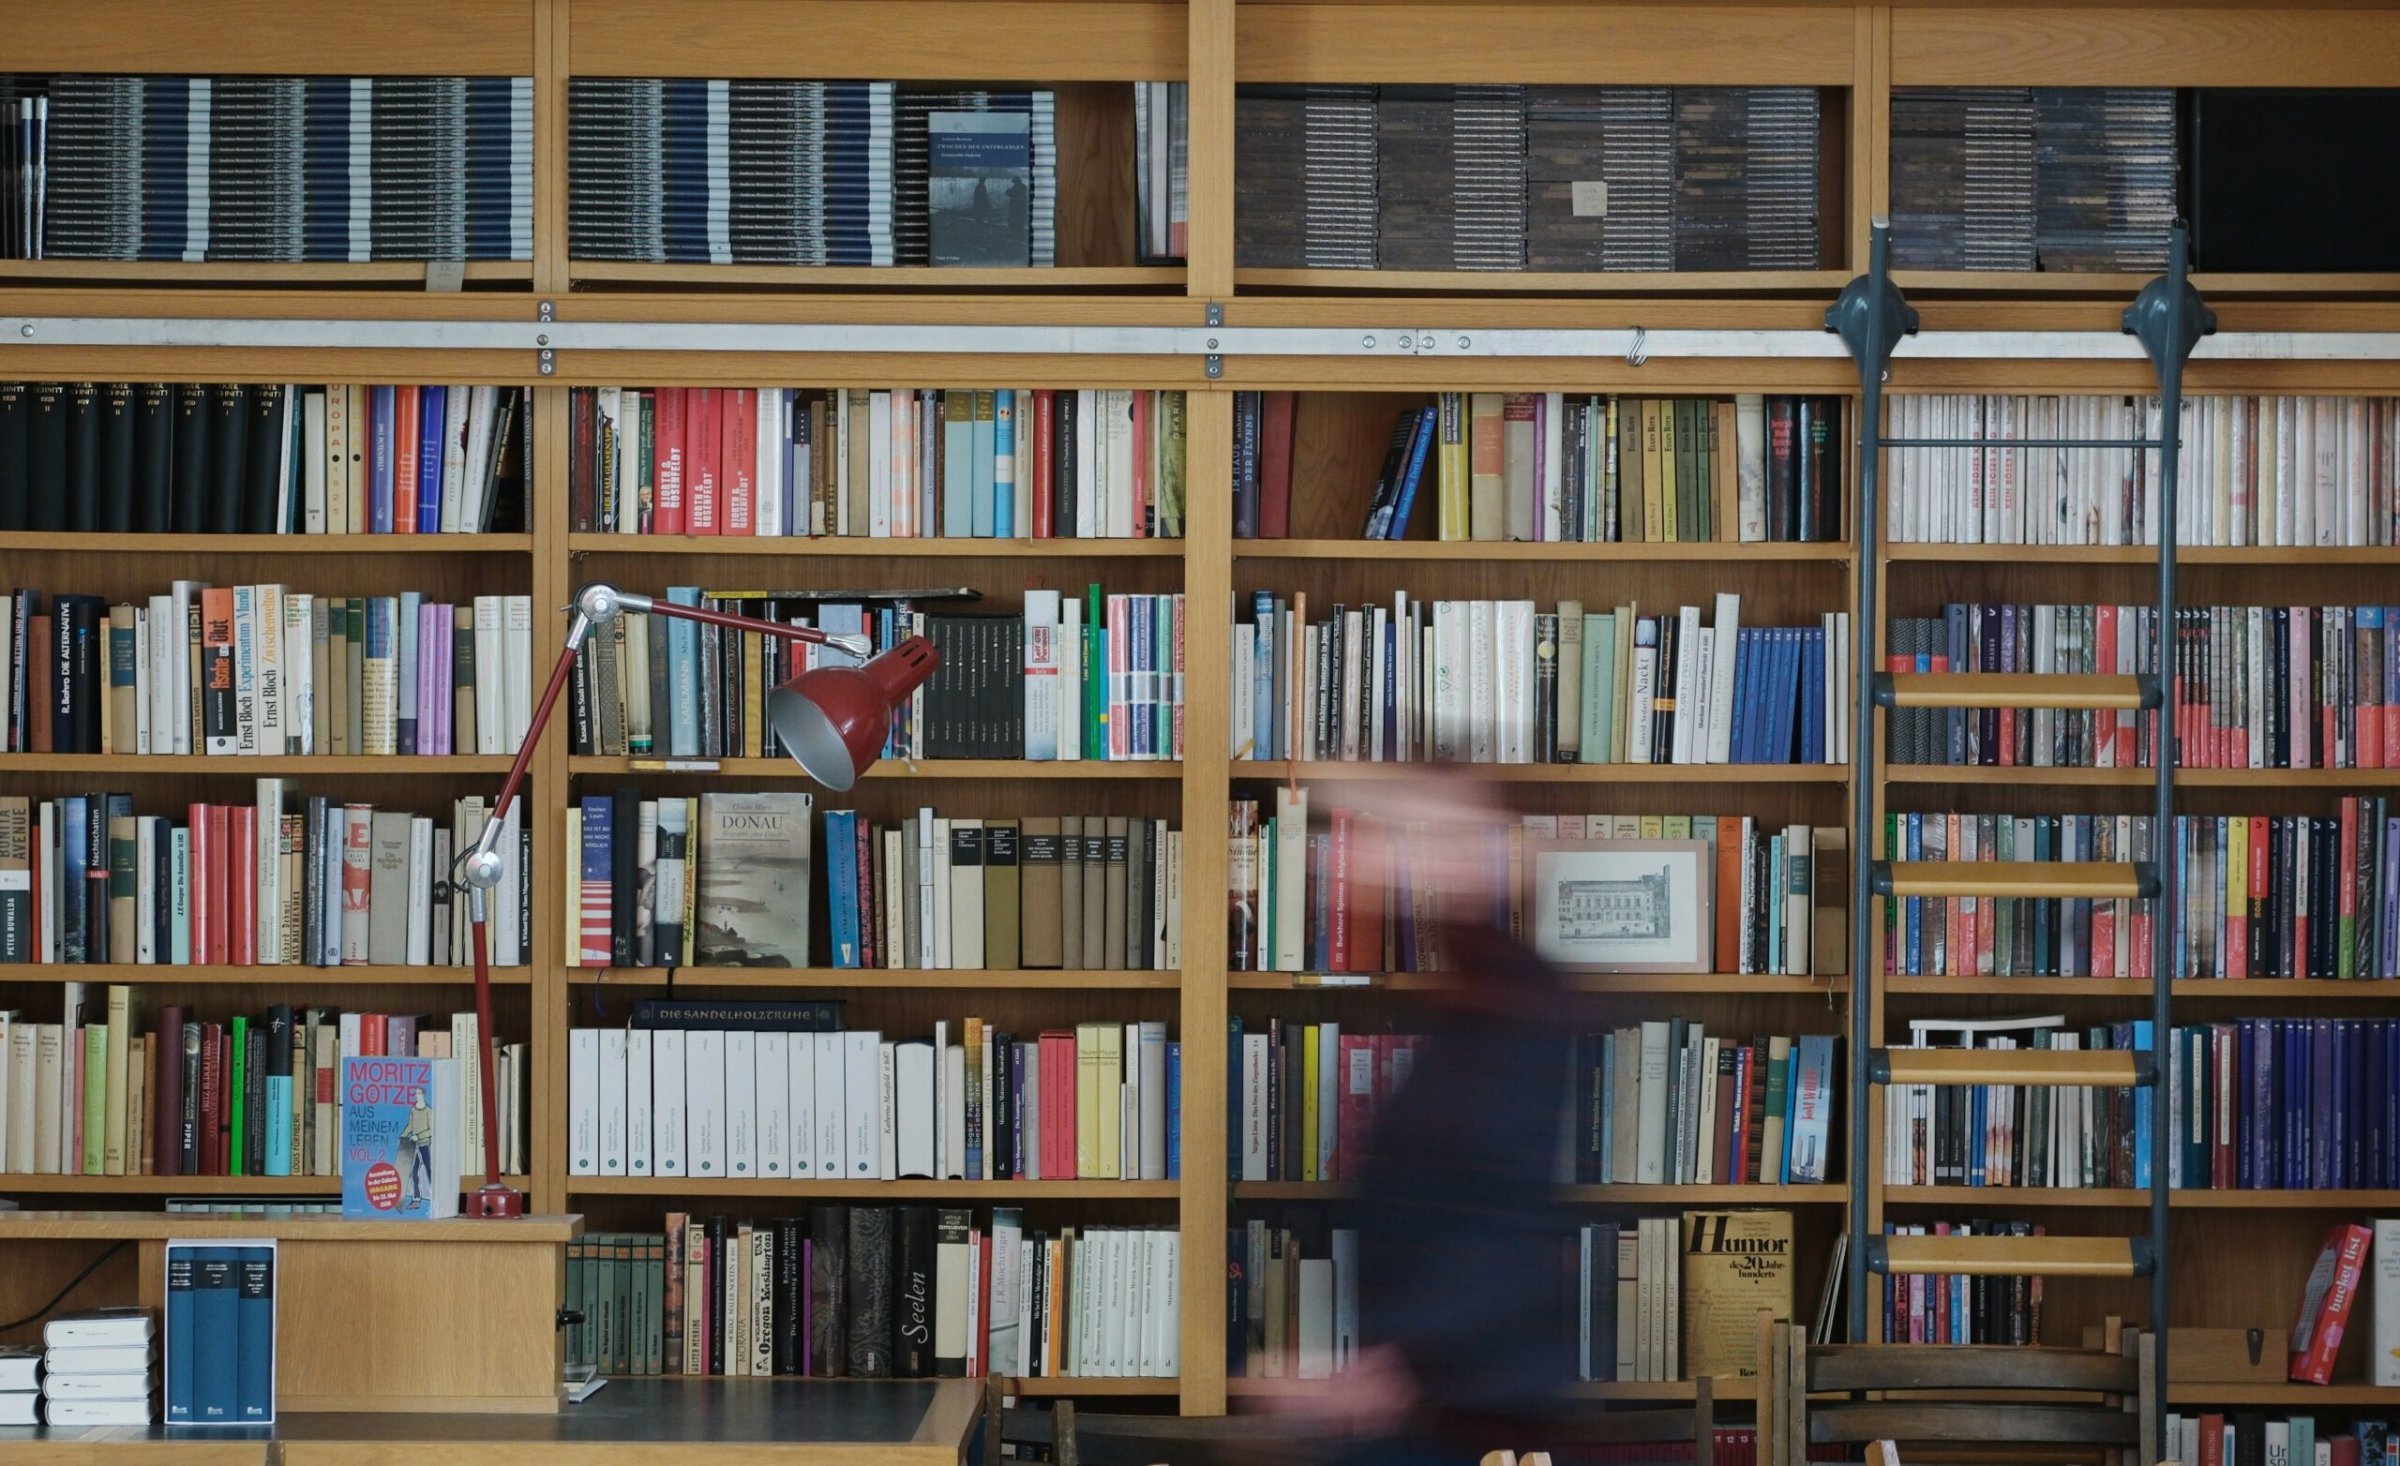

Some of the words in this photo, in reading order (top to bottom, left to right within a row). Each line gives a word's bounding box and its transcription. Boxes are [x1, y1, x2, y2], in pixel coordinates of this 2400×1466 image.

[1244, 414, 1253, 456] FLYNNS
[1627, 416, 1636, 432] ROTH
[1648, 416, 1656, 432] ROTH
[1664, 416, 1672, 432] ROTH
[1972, 432, 1980, 455] KD
[1989, 432, 1997, 455] KD
[2005, 432, 2013, 455] KD
[661, 460, 671, 469] &
[1232, 443, 1241, 475] HAUS
[1244, 460, 1253, 481] DER
[604, 475, 612, 494] FALL
[671, 447, 681, 508] ROSENFELDT
[693, 484, 703, 492] &
[1232, 479, 1241, 492] IM
[661, 472, 671, 509] HJORTH
[702, 472, 713, 528] ROSENFELDT
[739, 476, 749, 528] ROSENFELDT
[604, 495, 612, 512] DER
[693, 492, 703, 527] HJORTH
[731, 495, 740, 528] HJORTH
[234, 588, 251, 619] Mundi
[61, 602, 70, 659] ALTERNATIVE
[208, 619, 229, 642] Glut
[261, 588, 276, 664] Zwischenwelten
[1034, 629, 1041, 643] GW
[1319, 626, 1328, 644] Japan
[1040, 629, 1048, 661] Persson
[61, 661, 70, 675] DIE
[236, 623, 255, 692] Experimentum
[210, 657, 230, 689] Asche
[262, 669, 277, 697] Bloch
[576, 669, 585, 688] hinter
[1636, 658, 1649, 694] Nackt
[577, 688, 586, 705] Stadt
[681, 659, 690, 725] KARLMANN
[238, 696, 253, 722] Bloch
[262, 699, 277, 727] Ernst
[578, 706, 586, 717] Die
[1319, 692, 1328, 722] Schirmer
[1640, 697, 1648, 723] Sedaris
[239, 724, 254, 750] Ernst
[579, 720, 587, 743] Kasack
[1319, 722, 1328, 741] Bernd
[1639, 724, 1647, 746] David
[721, 814, 783, 830] DONAU
[12, 808, 27, 860] AVENUE
[92, 809, 100, 866] Nachtschatten
[1337, 844, 1346, 878] Belgische
[1337, 882, 1346, 912] Spinnen
[7, 897, 15, 931] BUWALDA
[282, 900, 290, 929] Dehmel
[1337, 913, 1345, 947] Burkhard
[7, 933, 15, 956] PETER
[282, 934, 290, 964] Richard
[292, 946, 300, 960] MAX
[660, 1010, 681, 1020] DIE
[683, 1010, 811, 1020] SANDELHOLZTRUHE
[350, 1062, 430, 1084] MORITZ
[349, 1105, 375, 1119] AUS
[884, 1105, 892, 1134] Katherine
[1251, 1106, 1259, 1118] Das
[184, 1123, 192, 1149] PIPER
[349, 1120, 399, 1134] MEINEM
[349, 1134, 389, 1147] LEBEN
[1251, 1138, 1259, 1154] Vargas
[291, 1151, 301, 1174] LOUIS
[378, 1148, 386, 1162] 2
[755, 1234, 763, 1256] USA
[1687, 1215, 1788, 1253] Humor
[760, 1233, 772, 1302] Washington
[1738, 1269, 1775, 1279] hunderts
[2329, 1264, 2353, 1312] bucket
[2343, 1236, 2361, 1260] list
[901, 1272, 928, 1345] Seelen
[1034, 1302, 1042, 1320] Michel
[692, 1320, 700, 1347] MEHRING
[738, 1319, 746, 1363] MORAVIA
[759, 1306, 772, 1355] Oregon
[789, 1324, 798, 1336] Die
[692, 1349, 700, 1372] WALTER
[2269, 1444, 2286, 1457] Ur
